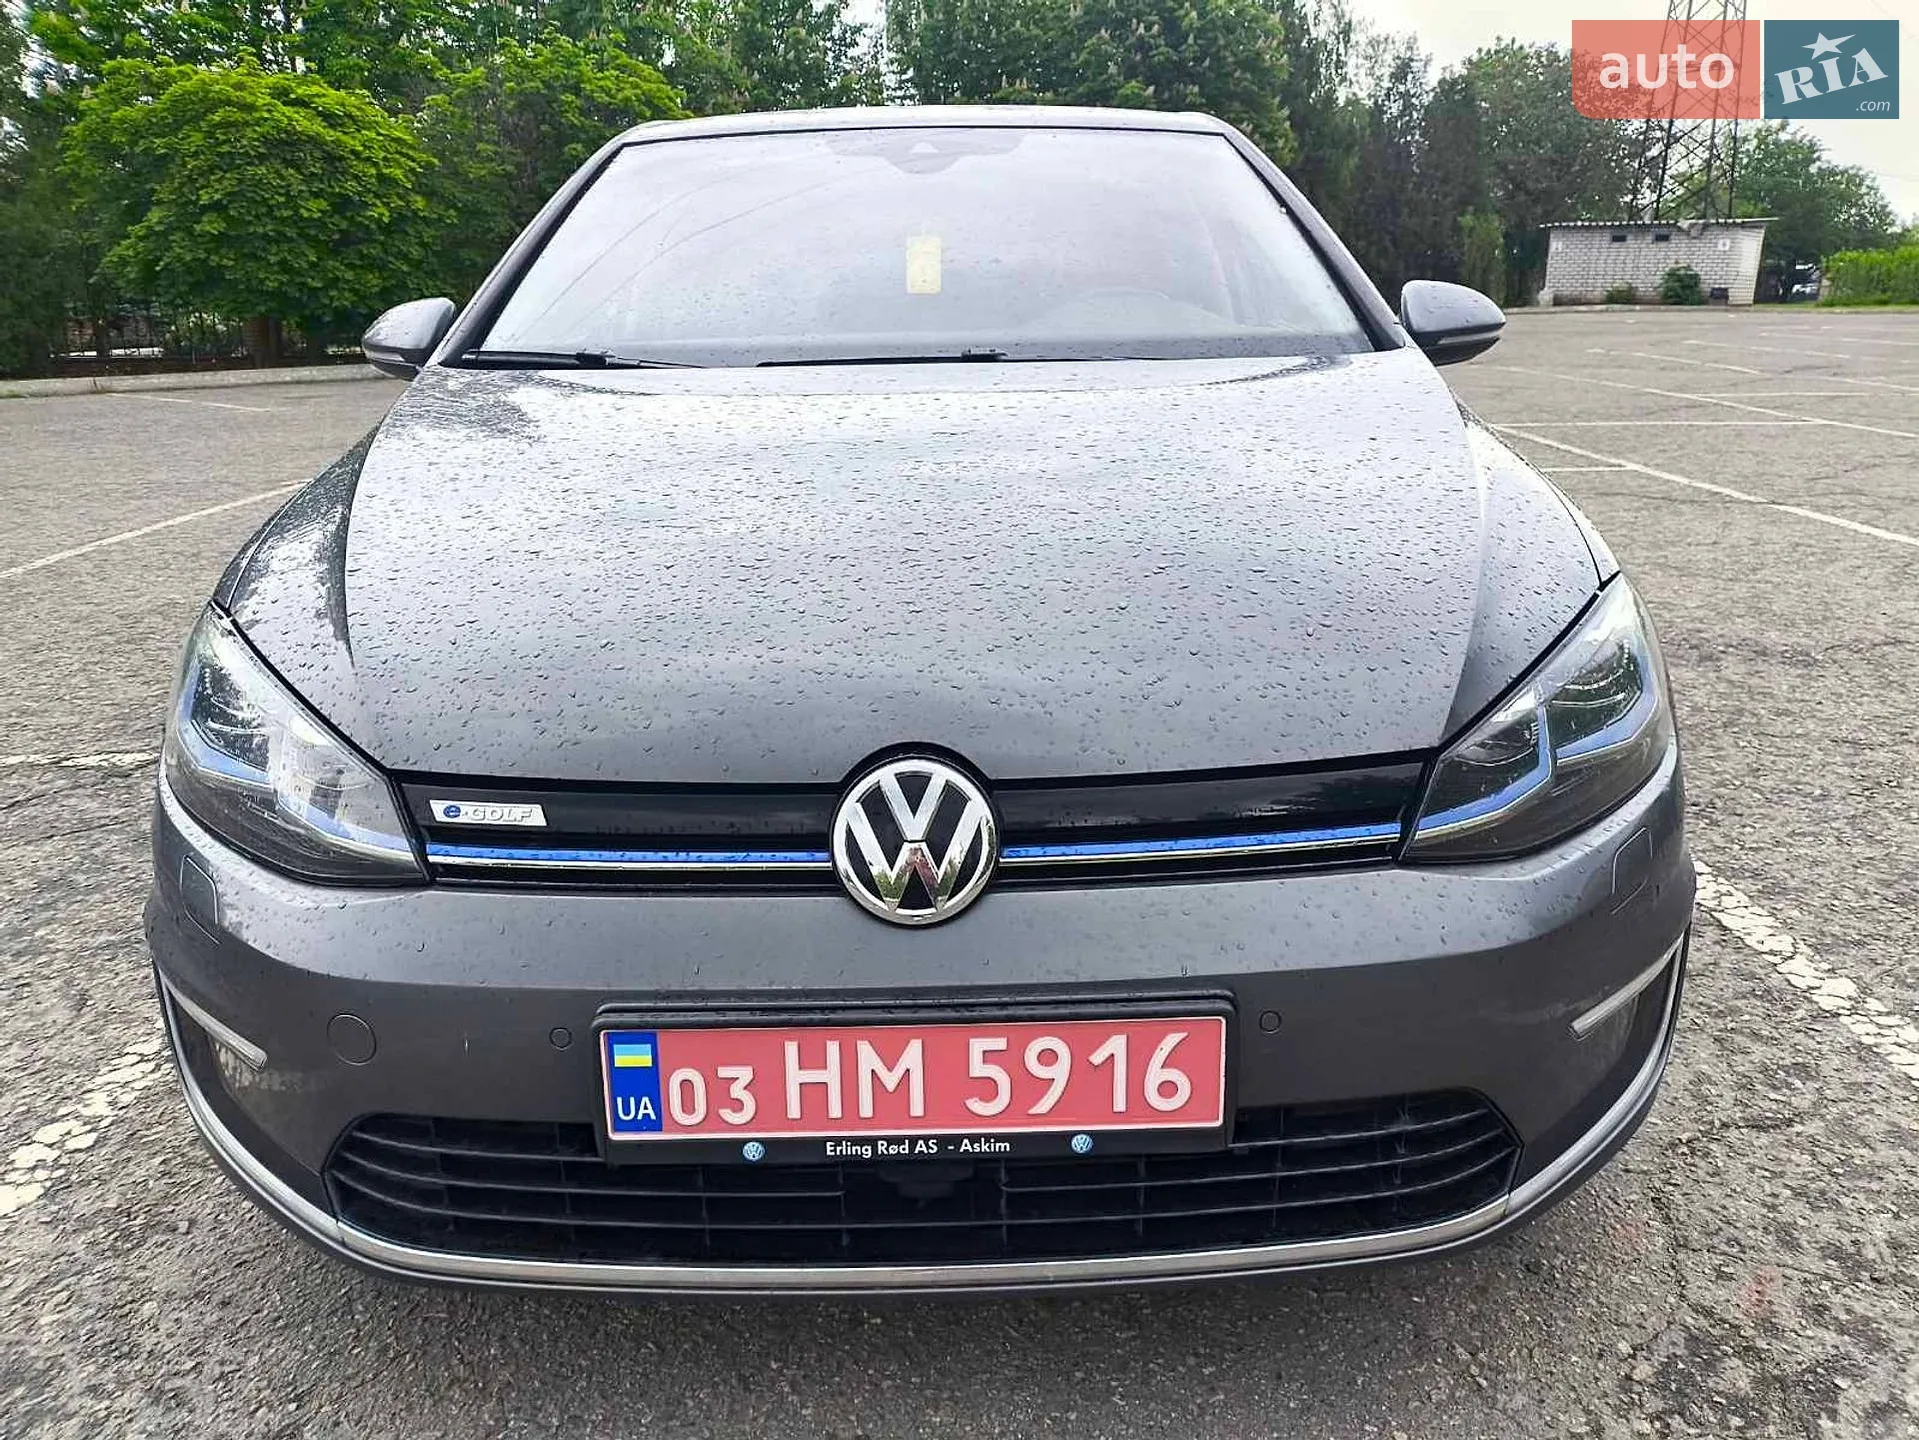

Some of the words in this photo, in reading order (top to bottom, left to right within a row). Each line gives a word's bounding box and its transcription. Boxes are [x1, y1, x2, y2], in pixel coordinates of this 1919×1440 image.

[668, 1065, 757, 1126] 03
[784, 1038, 925, 1120] HM
[964, 1031, 1192, 1117] 5916
[616, 1096, 656, 1121] UA
[826, 1141, 872, 1158] Erling
[877, 1139, 909, 1155] Rød
[914, 1139, 938, 1154] AS
[959, 1137, 1010, 1153] Askim
